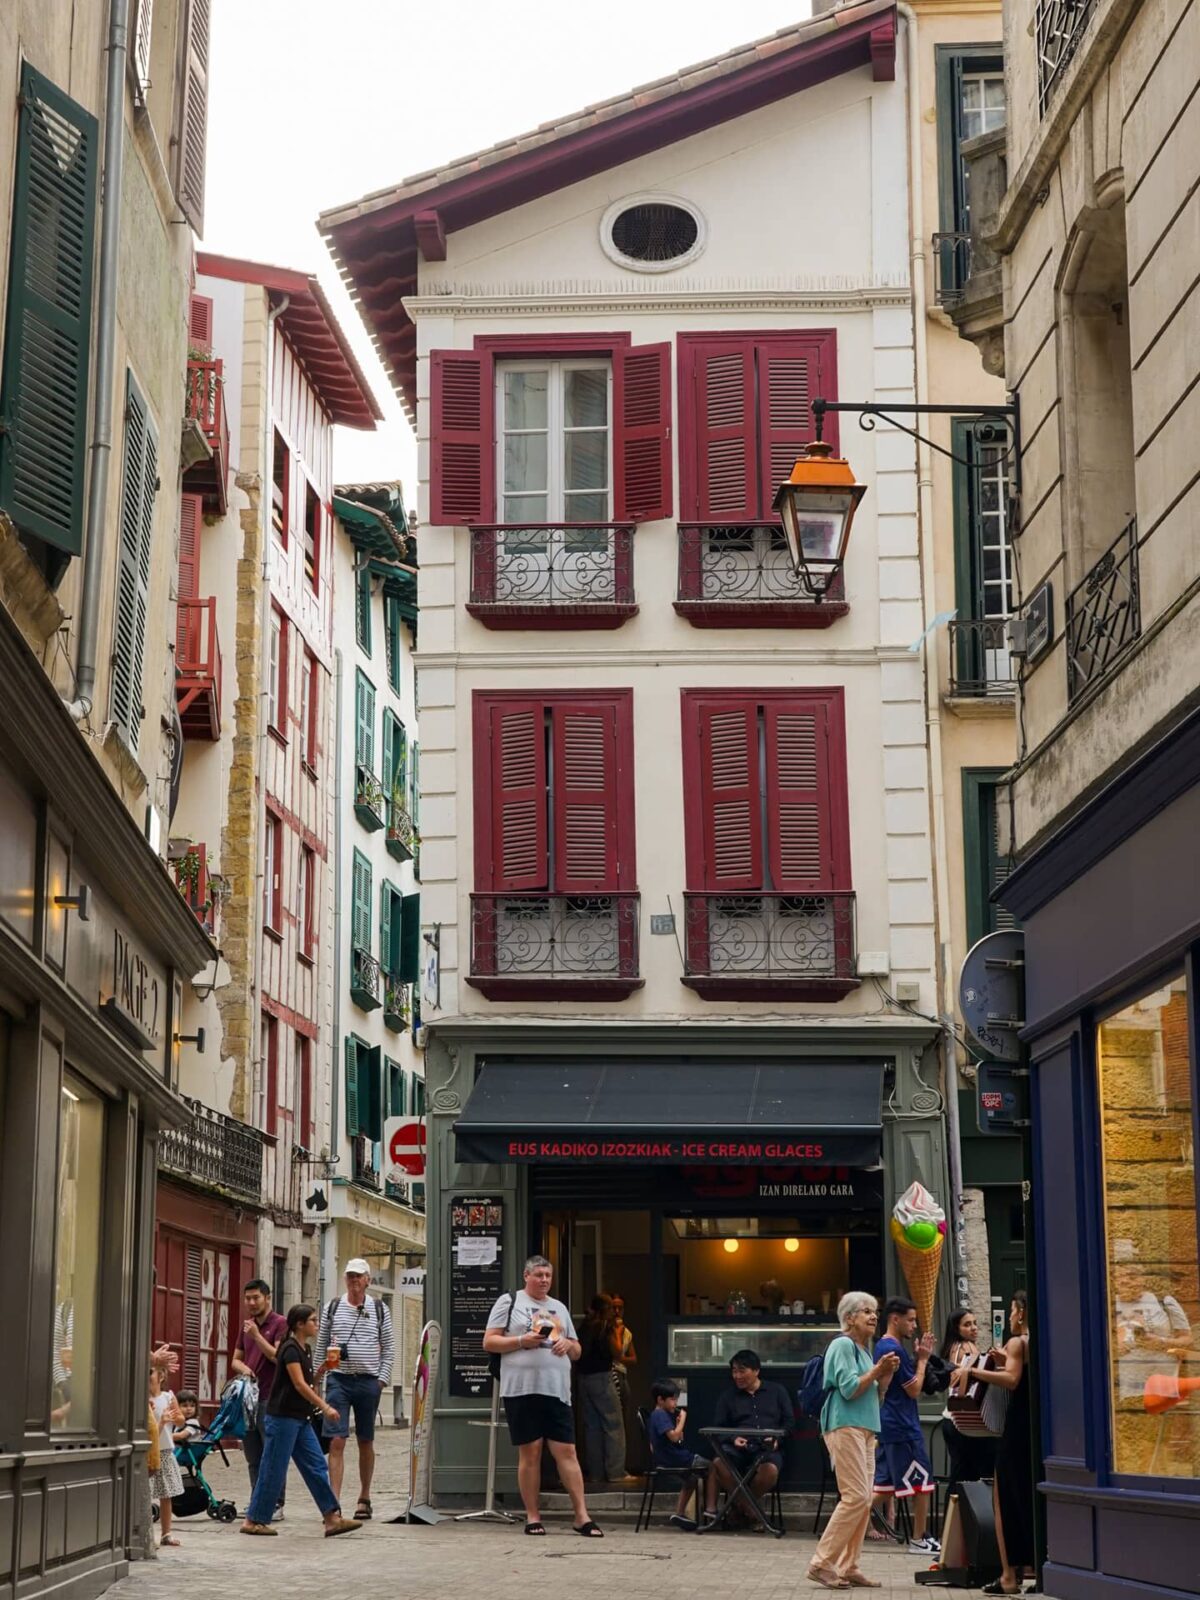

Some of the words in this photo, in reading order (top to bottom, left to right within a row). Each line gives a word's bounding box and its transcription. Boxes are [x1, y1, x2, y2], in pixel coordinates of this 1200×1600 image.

[601, 1143, 672, 1156] IZOZKIAK
[682, 1143, 705, 1157] ICE
[708, 1143, 761, 1157] CREAM
[765, 1144, 823, 1158] GLACES
[759, 1185, 780, 1197] IZAN
[783, 1184, 827, 1196] DIRELAKO
[829, 1184, 854, 1196] GARA
